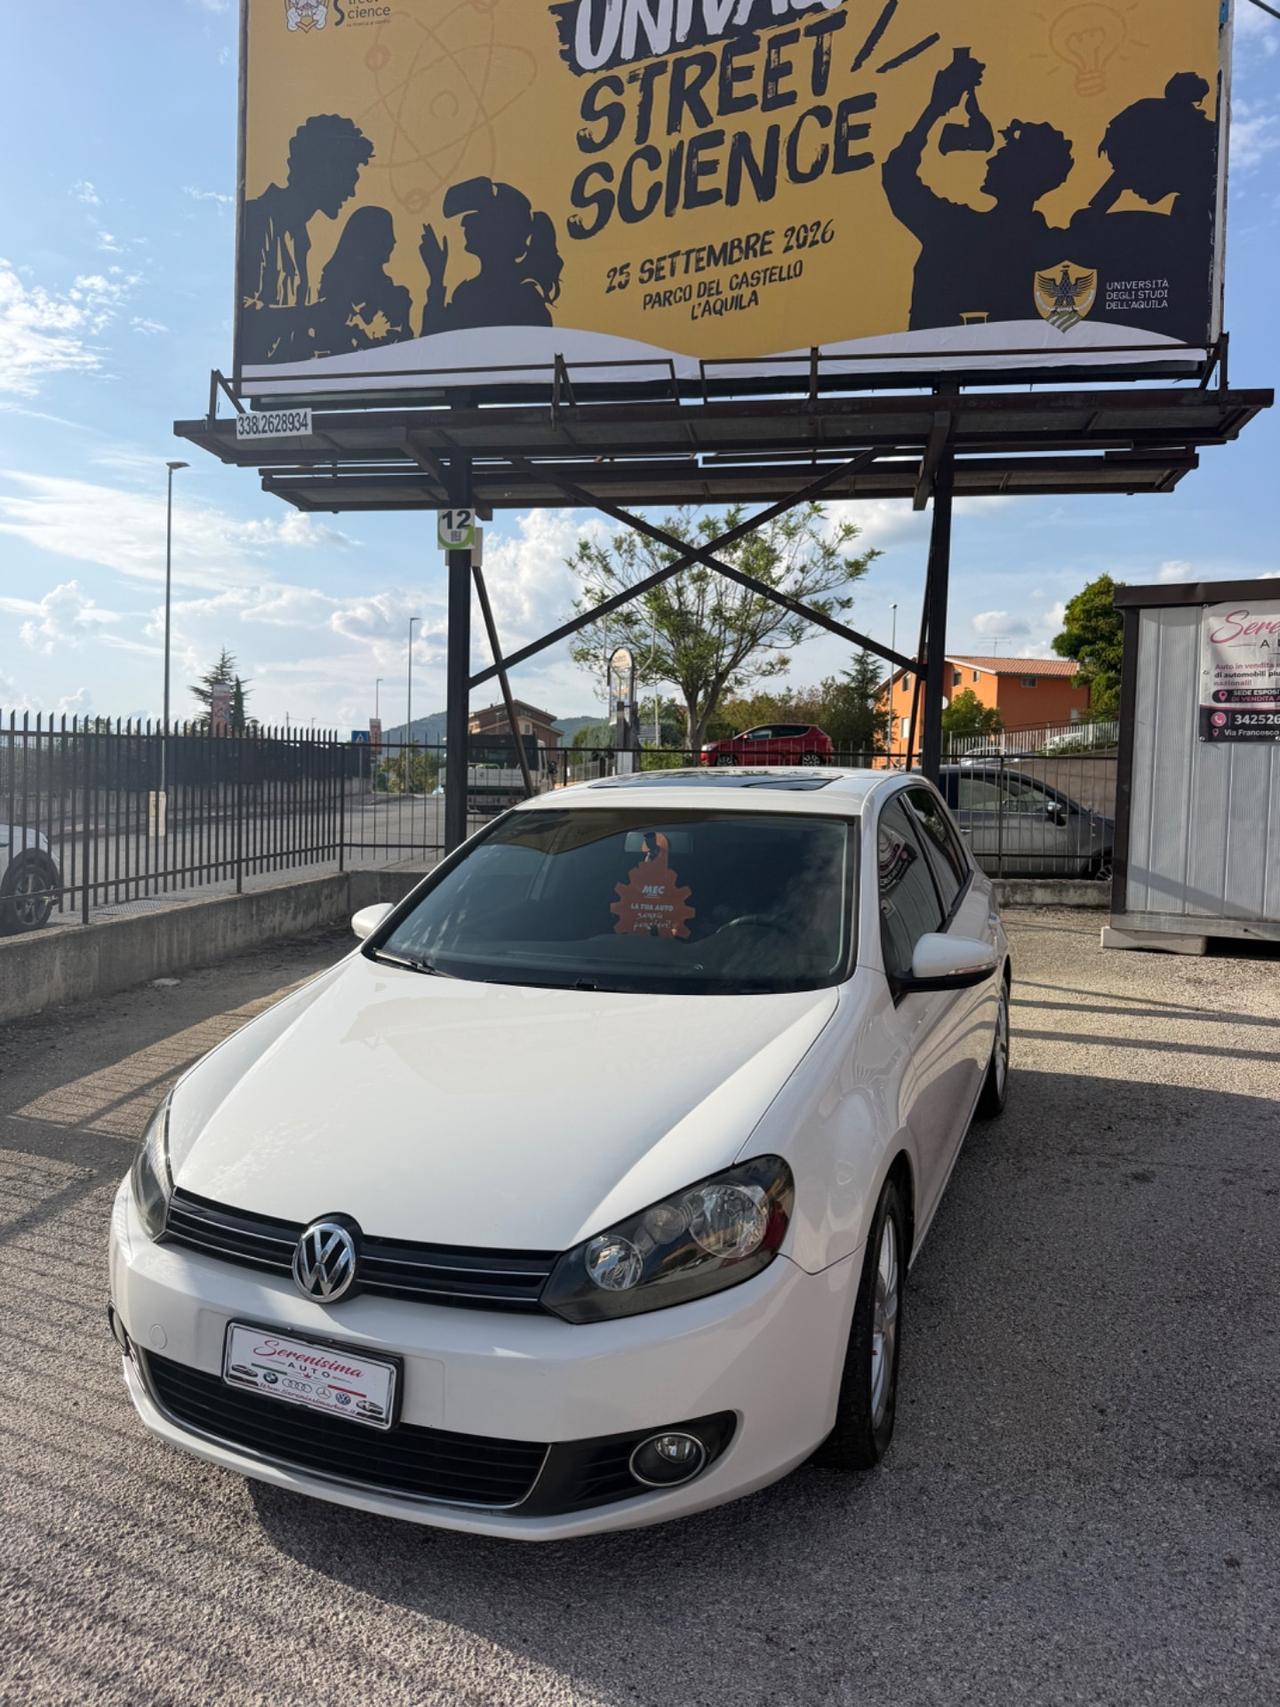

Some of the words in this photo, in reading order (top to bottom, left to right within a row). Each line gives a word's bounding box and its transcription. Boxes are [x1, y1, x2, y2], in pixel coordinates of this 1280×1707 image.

[576, 10, 847, 154] STREET
[566, 92, 877, 240] SCIENCE
[605, 263, 631, 293] 25
[638, 230, 775, 284] SETTEMBRE
[783, 219, 835, 254] 2026
[642, 284, 693, 311] PARCO
[696, 277, 723, 299] DEL
[729, 260, 804, 291] CASTELLO
[1106, 278, 1169, 290] UNIVERSITÀ
[1106, 291, 1135, 300] DEGLI
[1138, 290, 1168, 299] STUDI
[691, 291, 759, 320] L'AQUILA
[1105, 300, 1168, 310] DELL'AQUILA
[238, 411, 309, 435] 338.2628934
[442, 510, 471, 529] 12
[1224, 670, 1266, 678] automobili
[1245, 661, 1274, 669] vendita
[642, 885, 665, 894] MEC
[253, 1339, 363, 1378] Serenisima
[288, 1362, 330, 1379] AUTO
